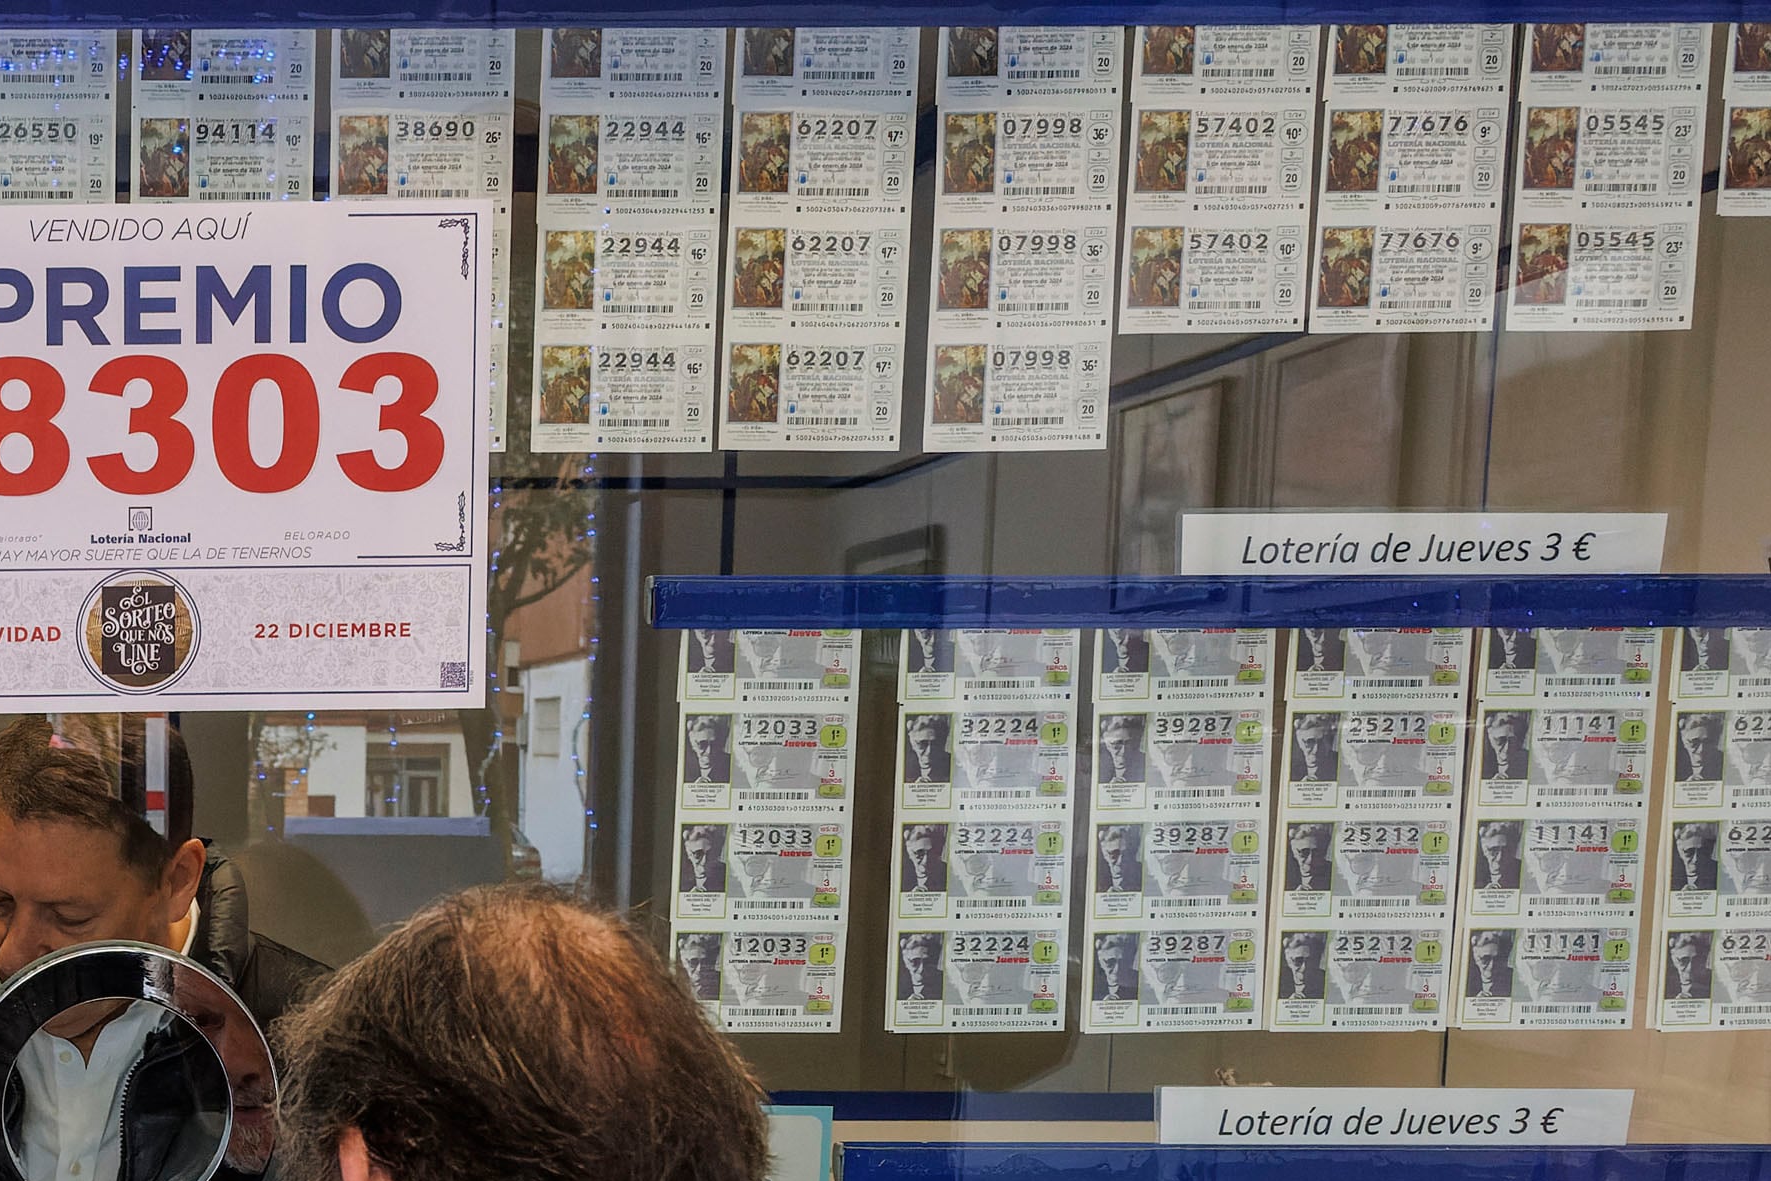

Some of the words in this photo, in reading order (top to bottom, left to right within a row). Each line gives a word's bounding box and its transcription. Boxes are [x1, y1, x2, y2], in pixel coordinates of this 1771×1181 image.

[396, 121, 476, 138] 38690
[606, 120, 686, 138] 22944
[796, 119, 877, 137] 62207
[1195, 116, 1276, 135] 57402
[1388, 115, 1469, 133] 77676
[1586, 113, 1665, 131] 05545
[196, 123, 276, 142] 94114
[29, 218, 163, 243] VENDIDO
[171, 212, 253, 242] AQUÍ
[998, 234, 1077, 252] 07998
[1189, 232, 1269, 250] 57402
[1087, 290, 1100, 300] 20
[598, 351, 677, 370] 22944
[90, 533, 134, 544] Lotería
[138, 532, 192, 544] Nacional
[284, 530, 351, 541] BELORADO
[25, 549, 81, 562] MAYOR
[84, 548, 143, 561] SUERTE
[146, 548, 180, 561] QUE
[182, 547, 202, 560] LA
[206, 547, 228, 560] DE
[231, 546, 313, 560] TENERNOS
[1241, 533, 1358, 566] Lotería
[1370, 532, 1411, 564] de
[1418, 533, 1531, 566] Jueves
[1540, 533, 1561, 562] 3
[1573, 532, 1596, 561] €
[102, 603, 176, 637] SORTEO
[119, 629, 146, 643] QUE
[147, 622, 176, 645] NOS
[254, 623, 279, 639] 22
[289, 622, 412, 638] DICIEMBRE
[112, 641, 162, 676] UNE
[743, 719, 818, 737] 12033
[1155, 717, 1232, 735] 39287
[1542, 716, 1617, 733] 11141
[958, 827, 1034, 844] 32224
[733, 937, 807, 954] 12033
[1335, 936, 1412, 952] 25212
[1218, 1107, 1333, 1137] Lotería
[1343, 1107, 1380, 1136] de
[1389, 1109, 1499, 1137] Jueves
[1508, 1108, 1529, 1135] 3
[1541, 1107, 1564, 1135] €
